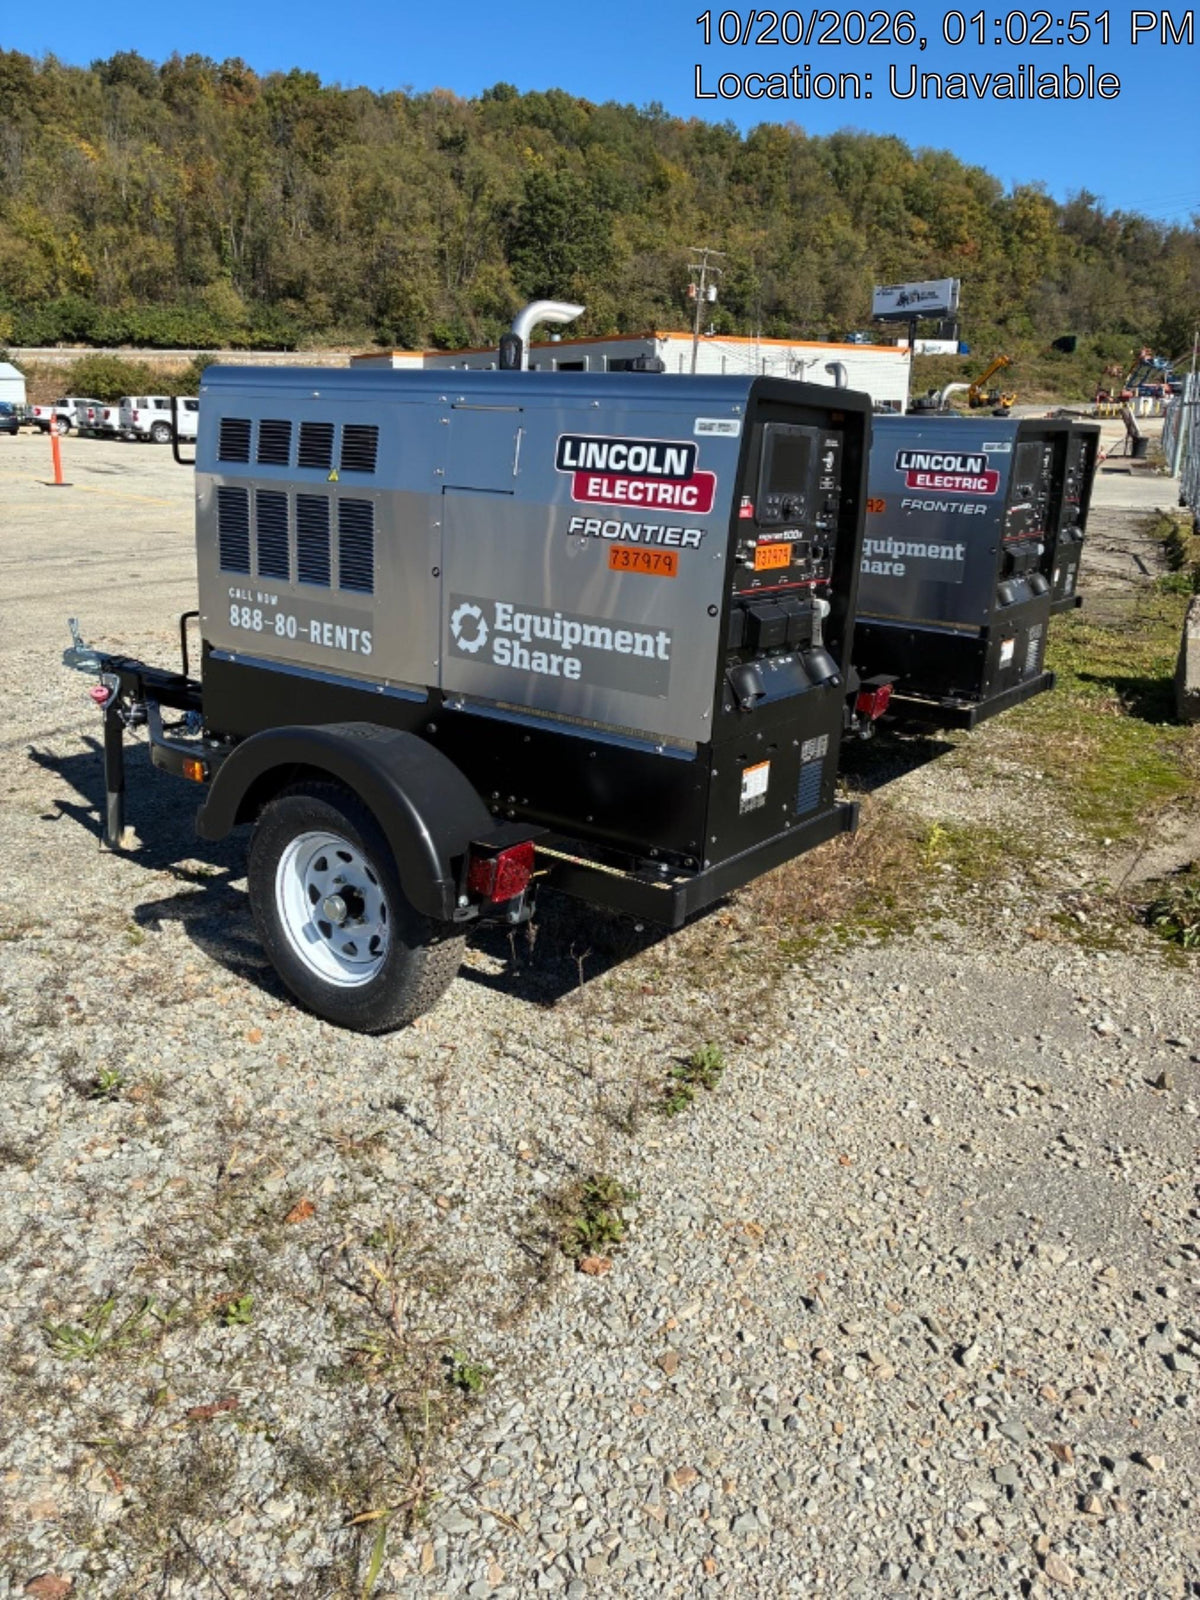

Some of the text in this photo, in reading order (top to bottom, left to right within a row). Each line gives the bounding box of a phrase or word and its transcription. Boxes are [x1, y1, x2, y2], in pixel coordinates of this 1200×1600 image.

[563, 440, 688, 476] LINCOLN
[899, 453, 982, 473] LINCOLN
[587, 477, 698, 506] ELECTRIC
[916, 474, 988, 490] ELECTRIC
[900, 499, 987, 515] FRONTIER
[568, 516, 703, 549] FRONTIER
[611, 549, 673, 571] 737979
[862, 537, 966, 561] quipment
[860, 559, 906, 576] hare
[228, 587, 278, 606] CALL NOW
[229, 604, 373, 656] 888-80-RENTS
[494, 601, 672, 661] Equipment
[492, 637, 582, 680] Share
